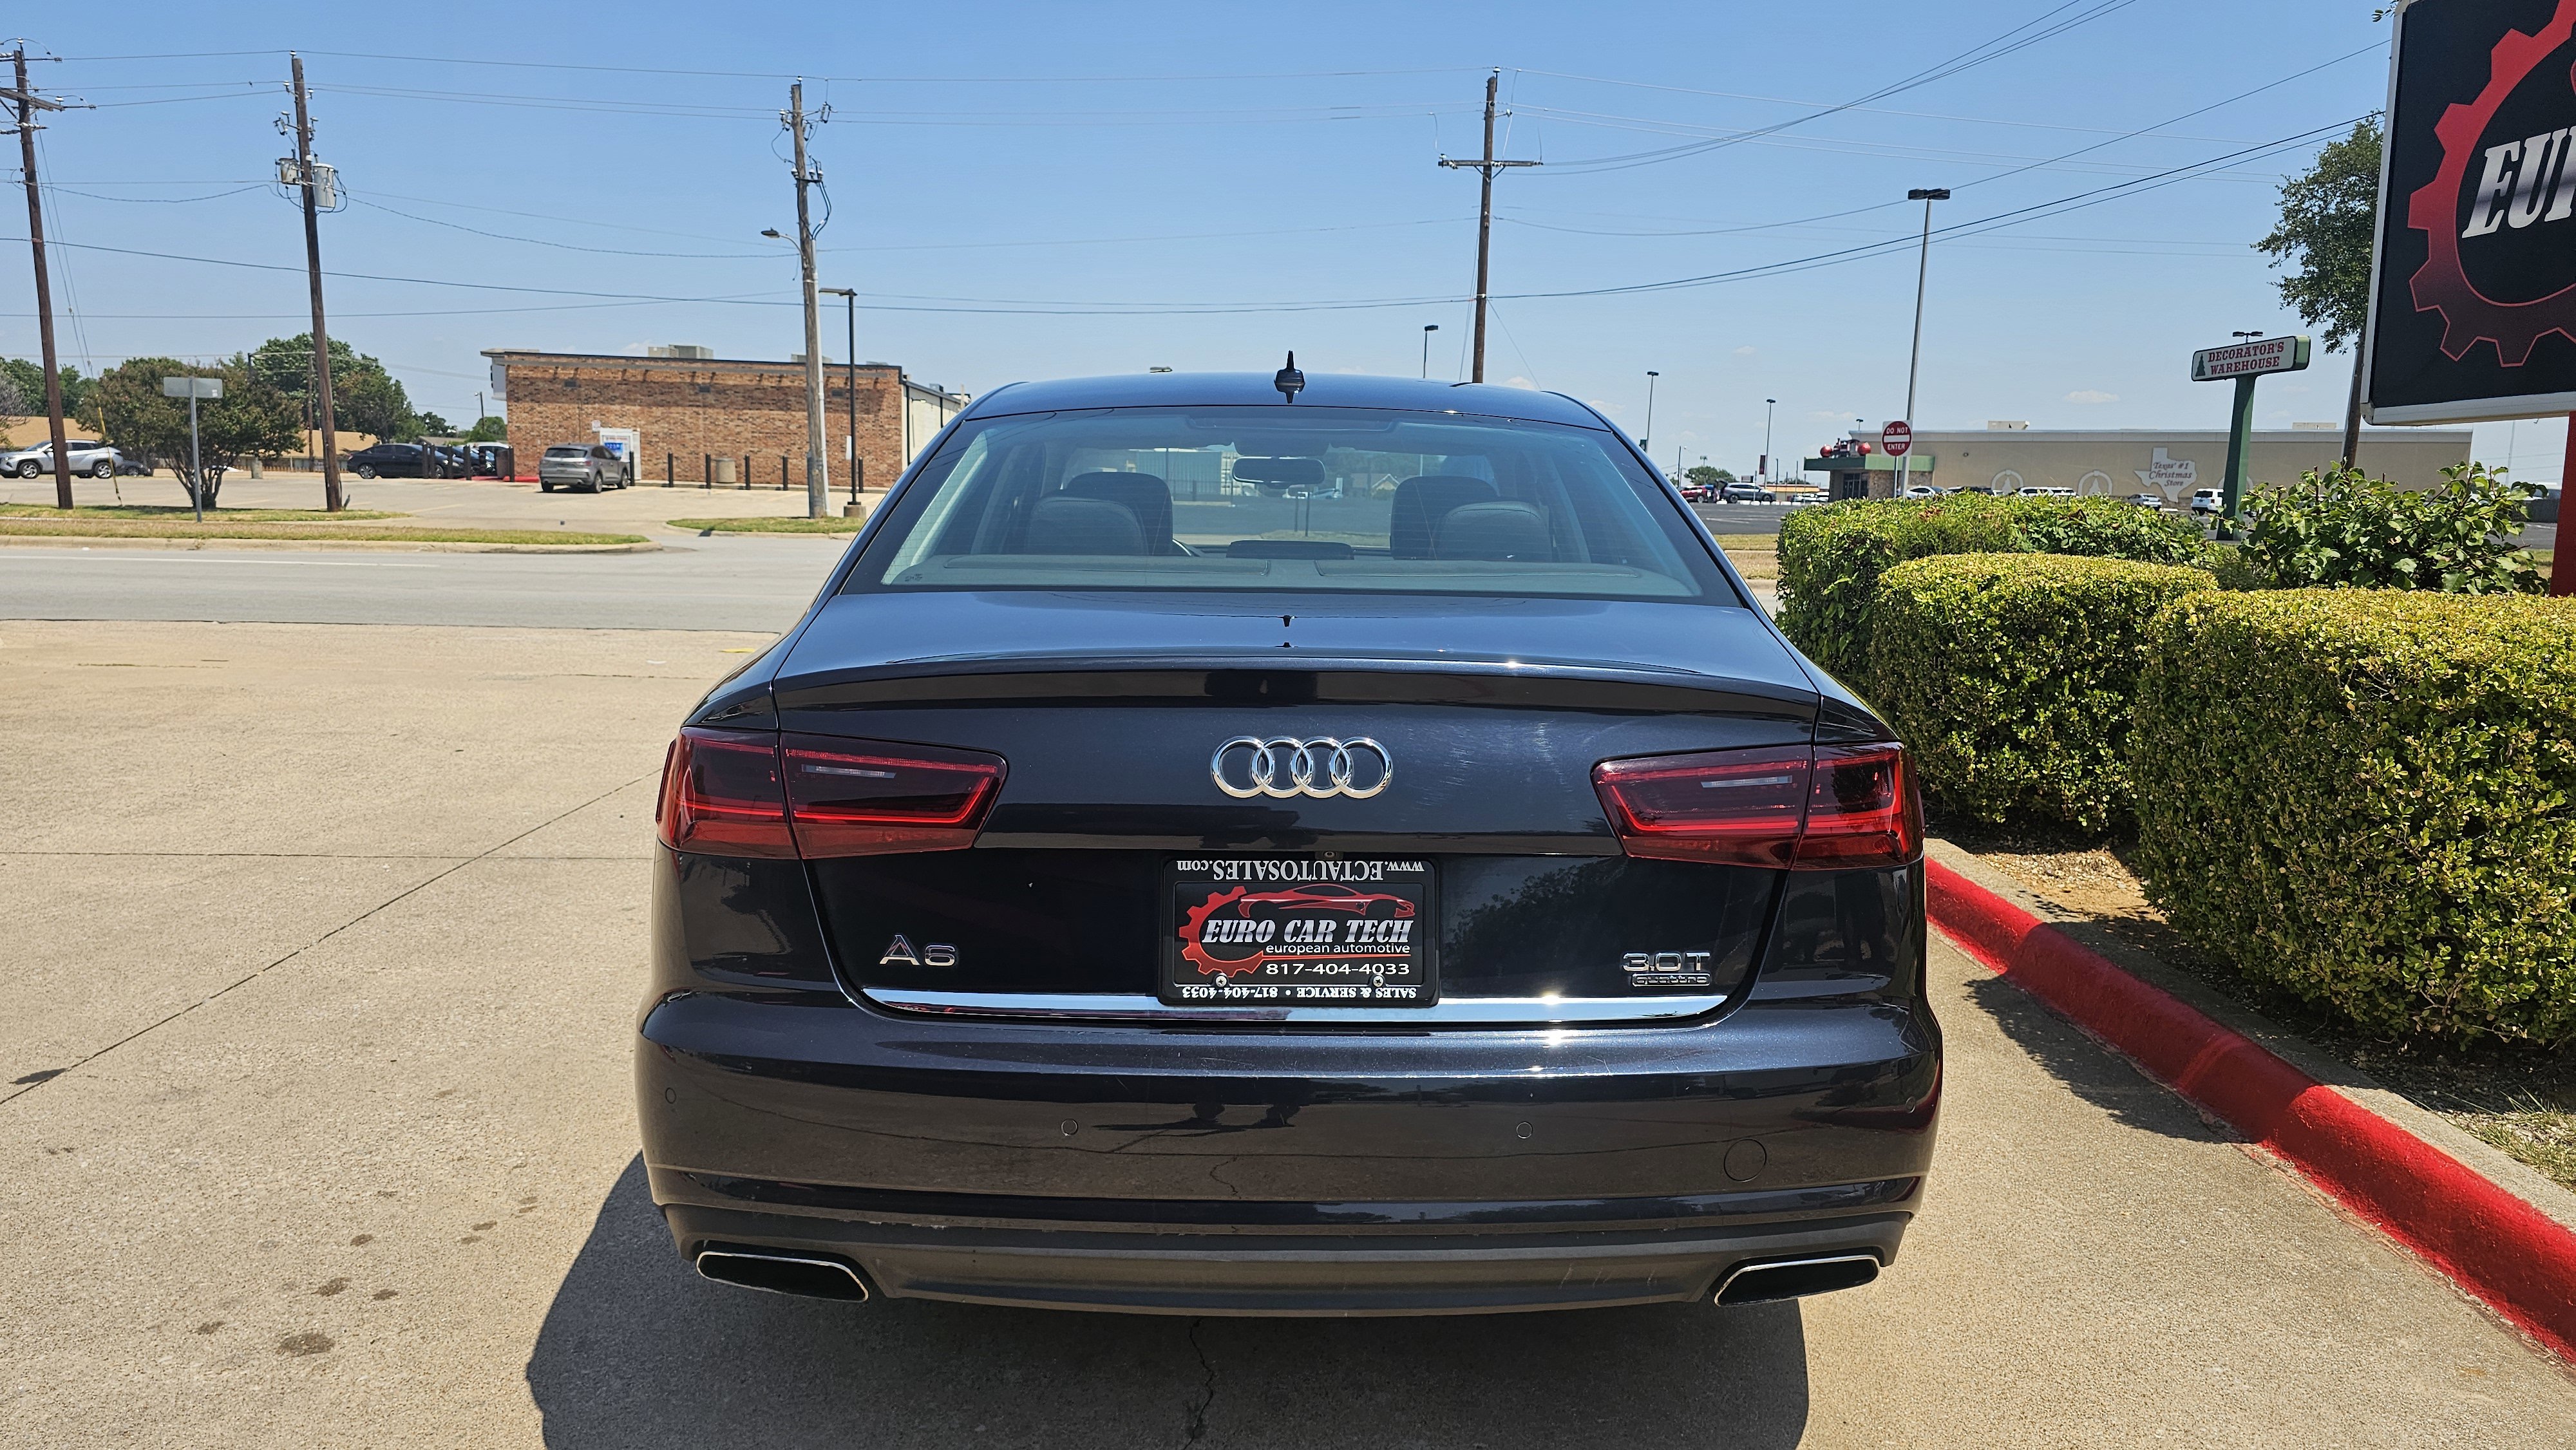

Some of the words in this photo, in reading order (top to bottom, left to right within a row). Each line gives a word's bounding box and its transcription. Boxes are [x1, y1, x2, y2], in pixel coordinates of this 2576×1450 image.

[2208, 341, 2284, 362] DECORATOR'S
[2210, 356, 2280, 375] WAREHOUSE
[2178, 462, 2189, 470] #1
[2149, 470, 2192, 480] Christmas
[1177, 860, 1425, 881] www.ECTAUTOSALES.com
[1202, 919, 1276, 943] EURO
[1283, 919, 1336, 943] CAR
[1346, 919, 1414, 943] TECH
[879, 934, 956, 966] A6
[1265, 944, 1330, 955] european
[1333, 943, 1410, 954] automotive
[1622, 952, 1710, 972] 3.0T
[1265, 963, 1410, 975] 817-404-4033
[1636, 975, 1707, 985] quattro
[1182, 986, 1278, 999] 817-404-4033
[1296, 987, 1357, 998] SERVICE
[1360, 987, 1372, 998] &
[1375, 987, 1417, 999] SALES
